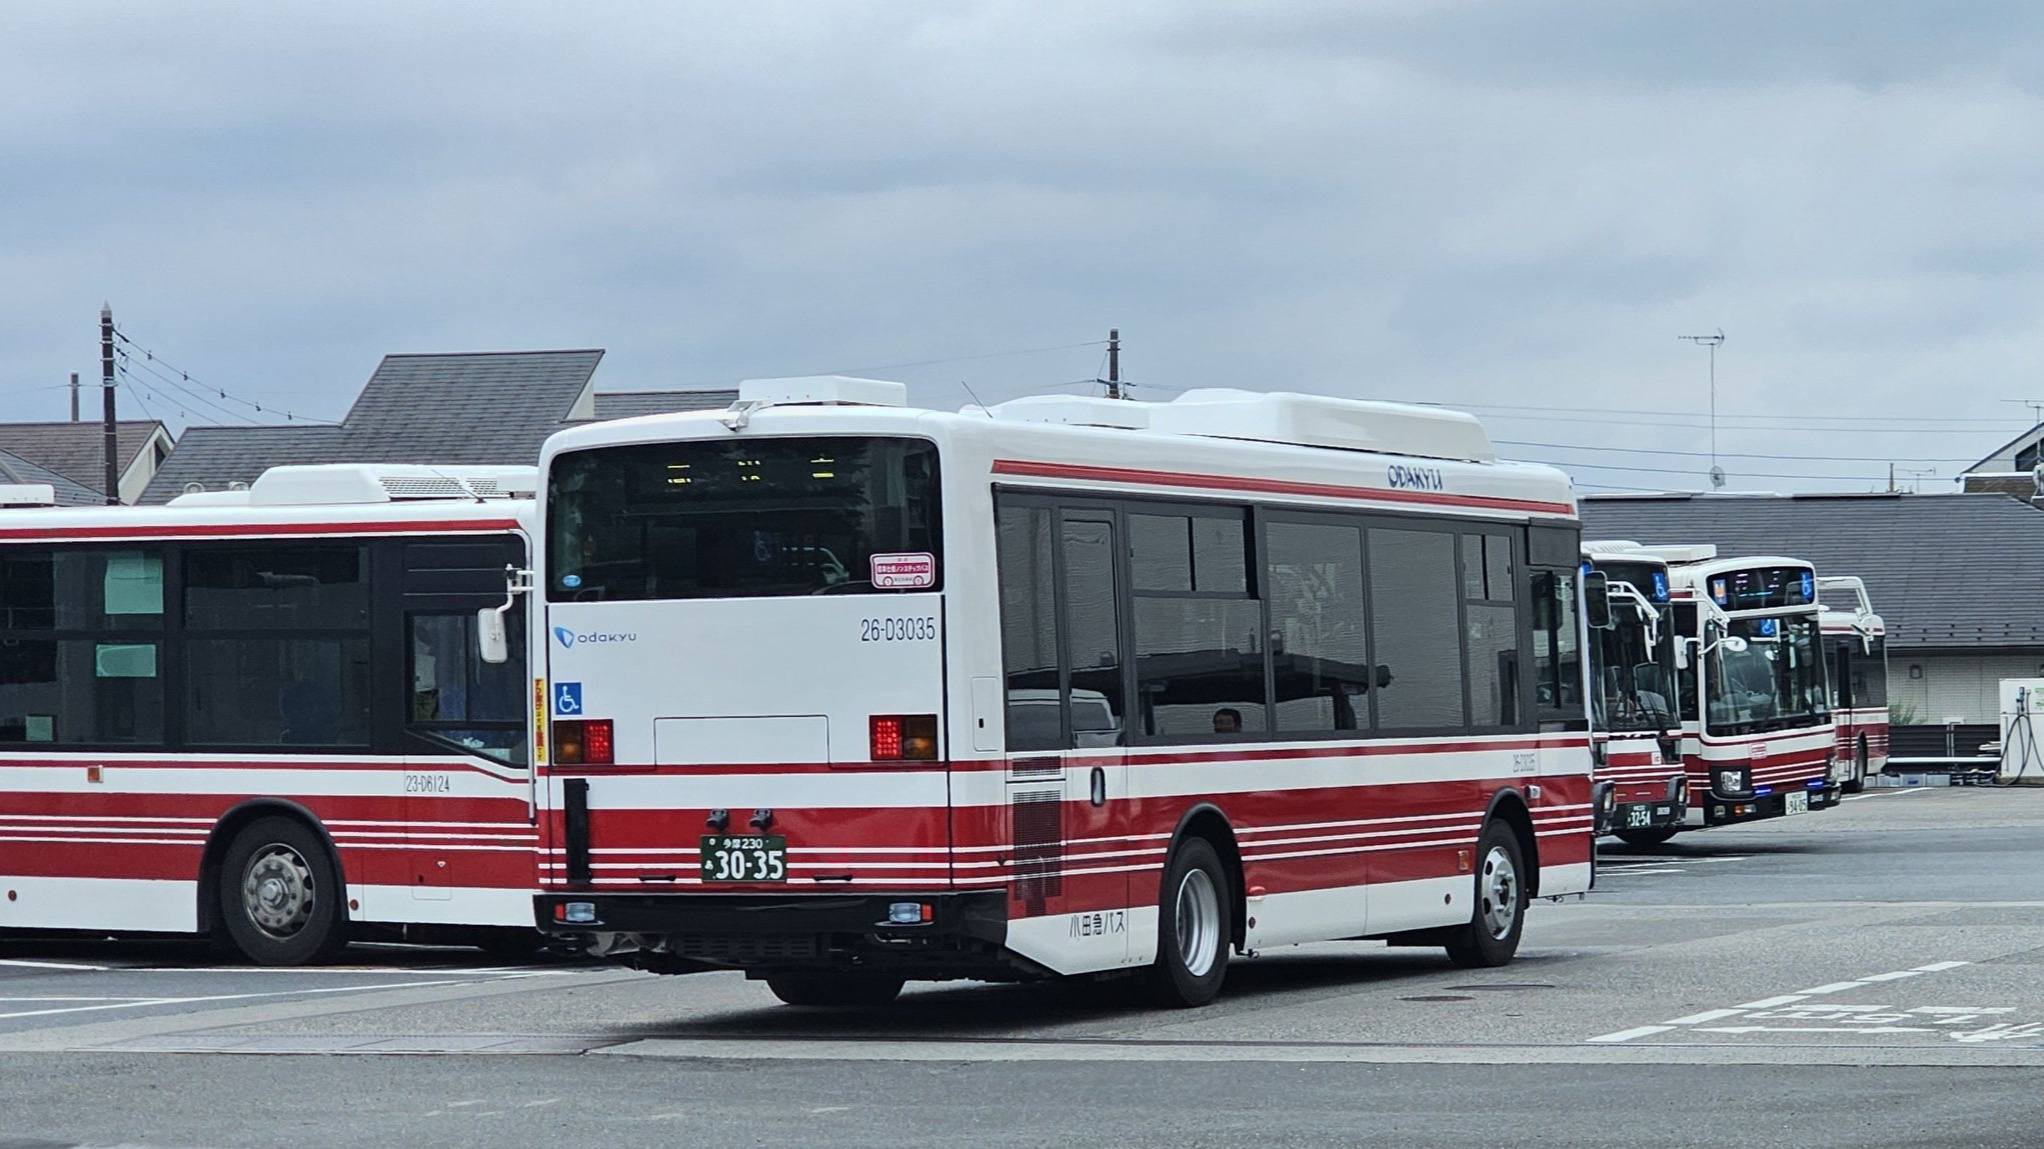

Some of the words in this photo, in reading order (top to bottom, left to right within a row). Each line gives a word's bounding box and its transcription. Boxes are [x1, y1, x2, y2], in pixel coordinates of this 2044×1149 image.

[1388, 465, 1443, 490] ODAKYU
[861, 617, 936, 641] 26-D3035
[406, 775, 450, 792] 23-D6124
[714, 850, 783, 879] 30-35
[1070, 911, 1126, 938] 小田急バス
